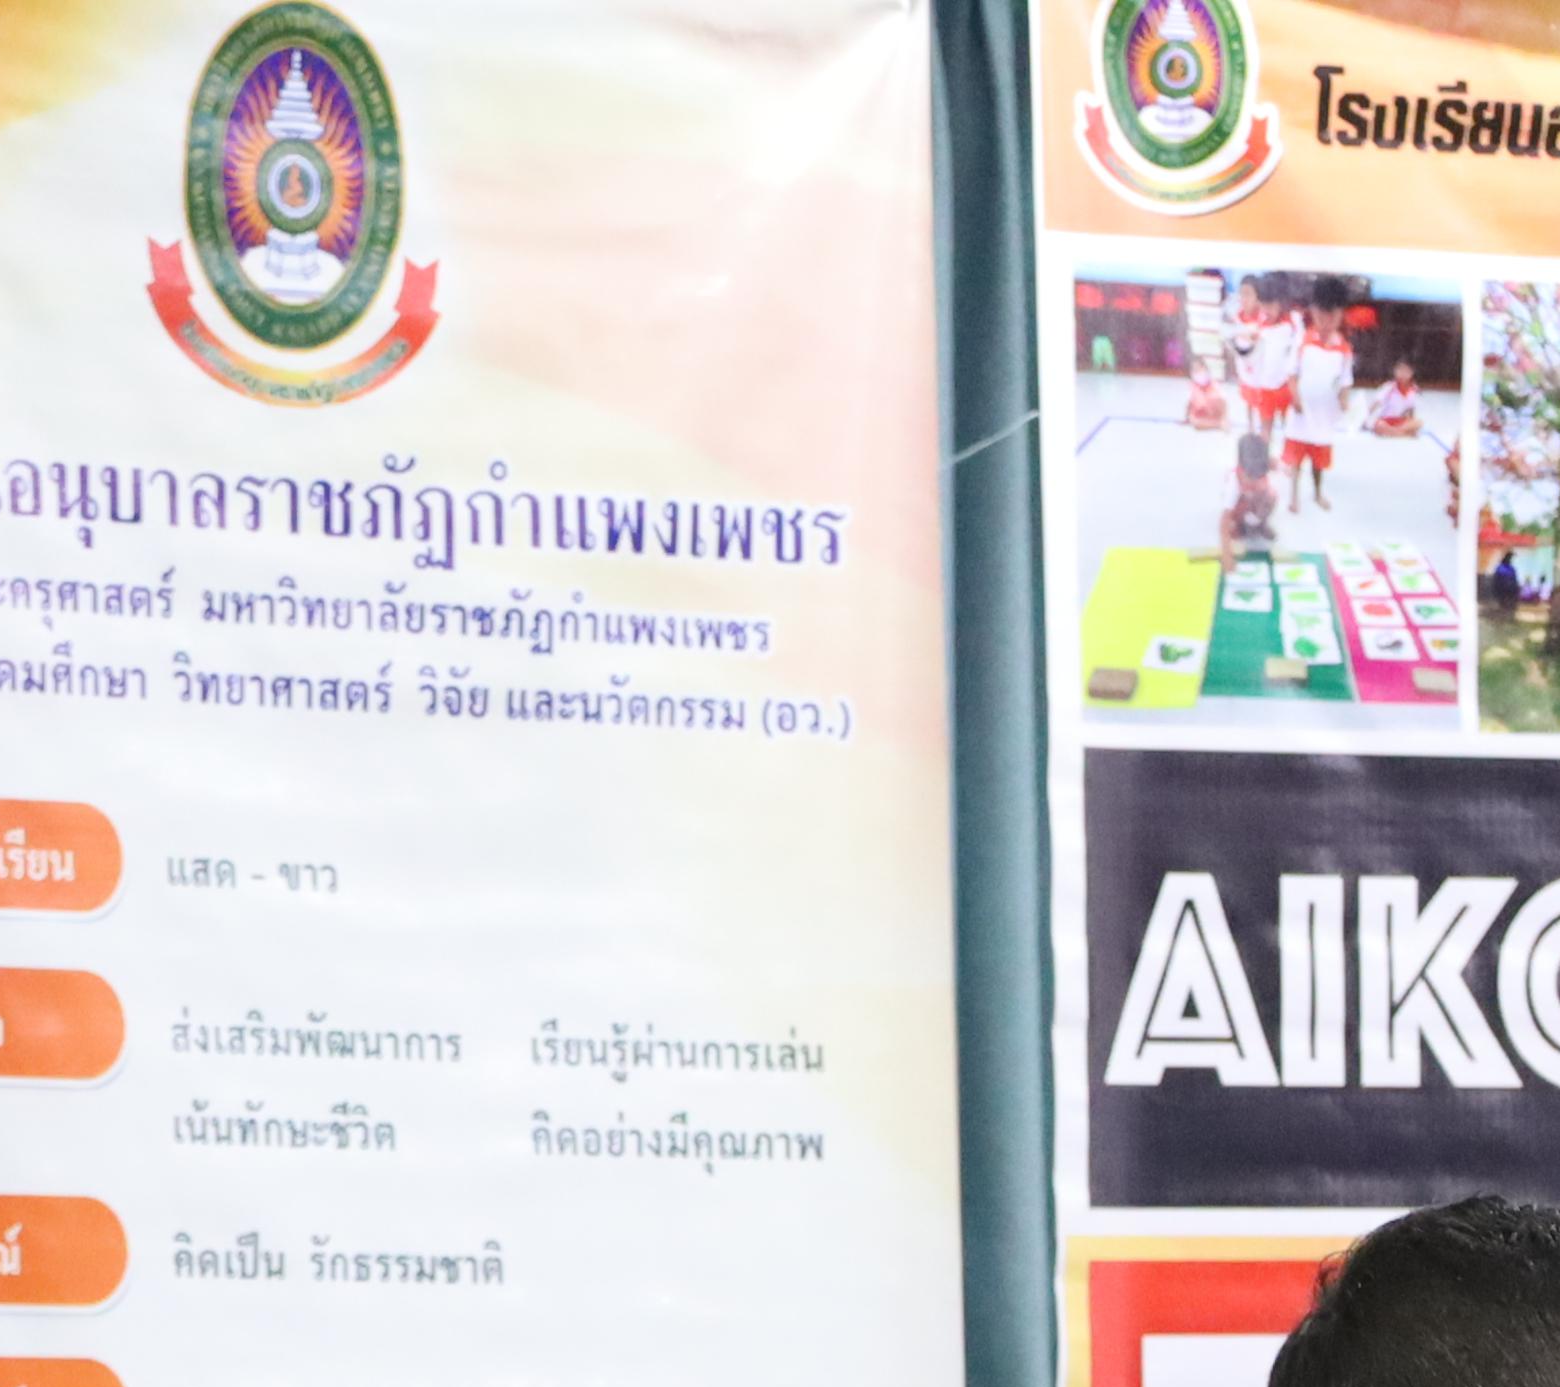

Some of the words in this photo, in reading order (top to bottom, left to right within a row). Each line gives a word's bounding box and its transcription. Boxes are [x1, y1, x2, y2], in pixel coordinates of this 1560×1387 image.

[201, 576, 771, 655] มหาวิทยาลัยราชภัฏกำแพงเพชร
[173, 651, 393, 714] วิทยาศาสตร์
[417, 665, 491, 719] วิจัย
[505, 675, 747, 731] และนวัตกรรม
[166, 855, 237, 889] แสด
[171, 1006, 463, 1062] ส่งเสริมพัฒนาการ
[530, 1018, 825, 1083] เรียนรู้ผ่านการเล่น
[172, 1099, 397, 1151] เน้นทักษะชีวิต
[172, 1231, 286, 1281] คิดเป็น
[309, 1234, 505, 1286] รักธรรมชาติ
